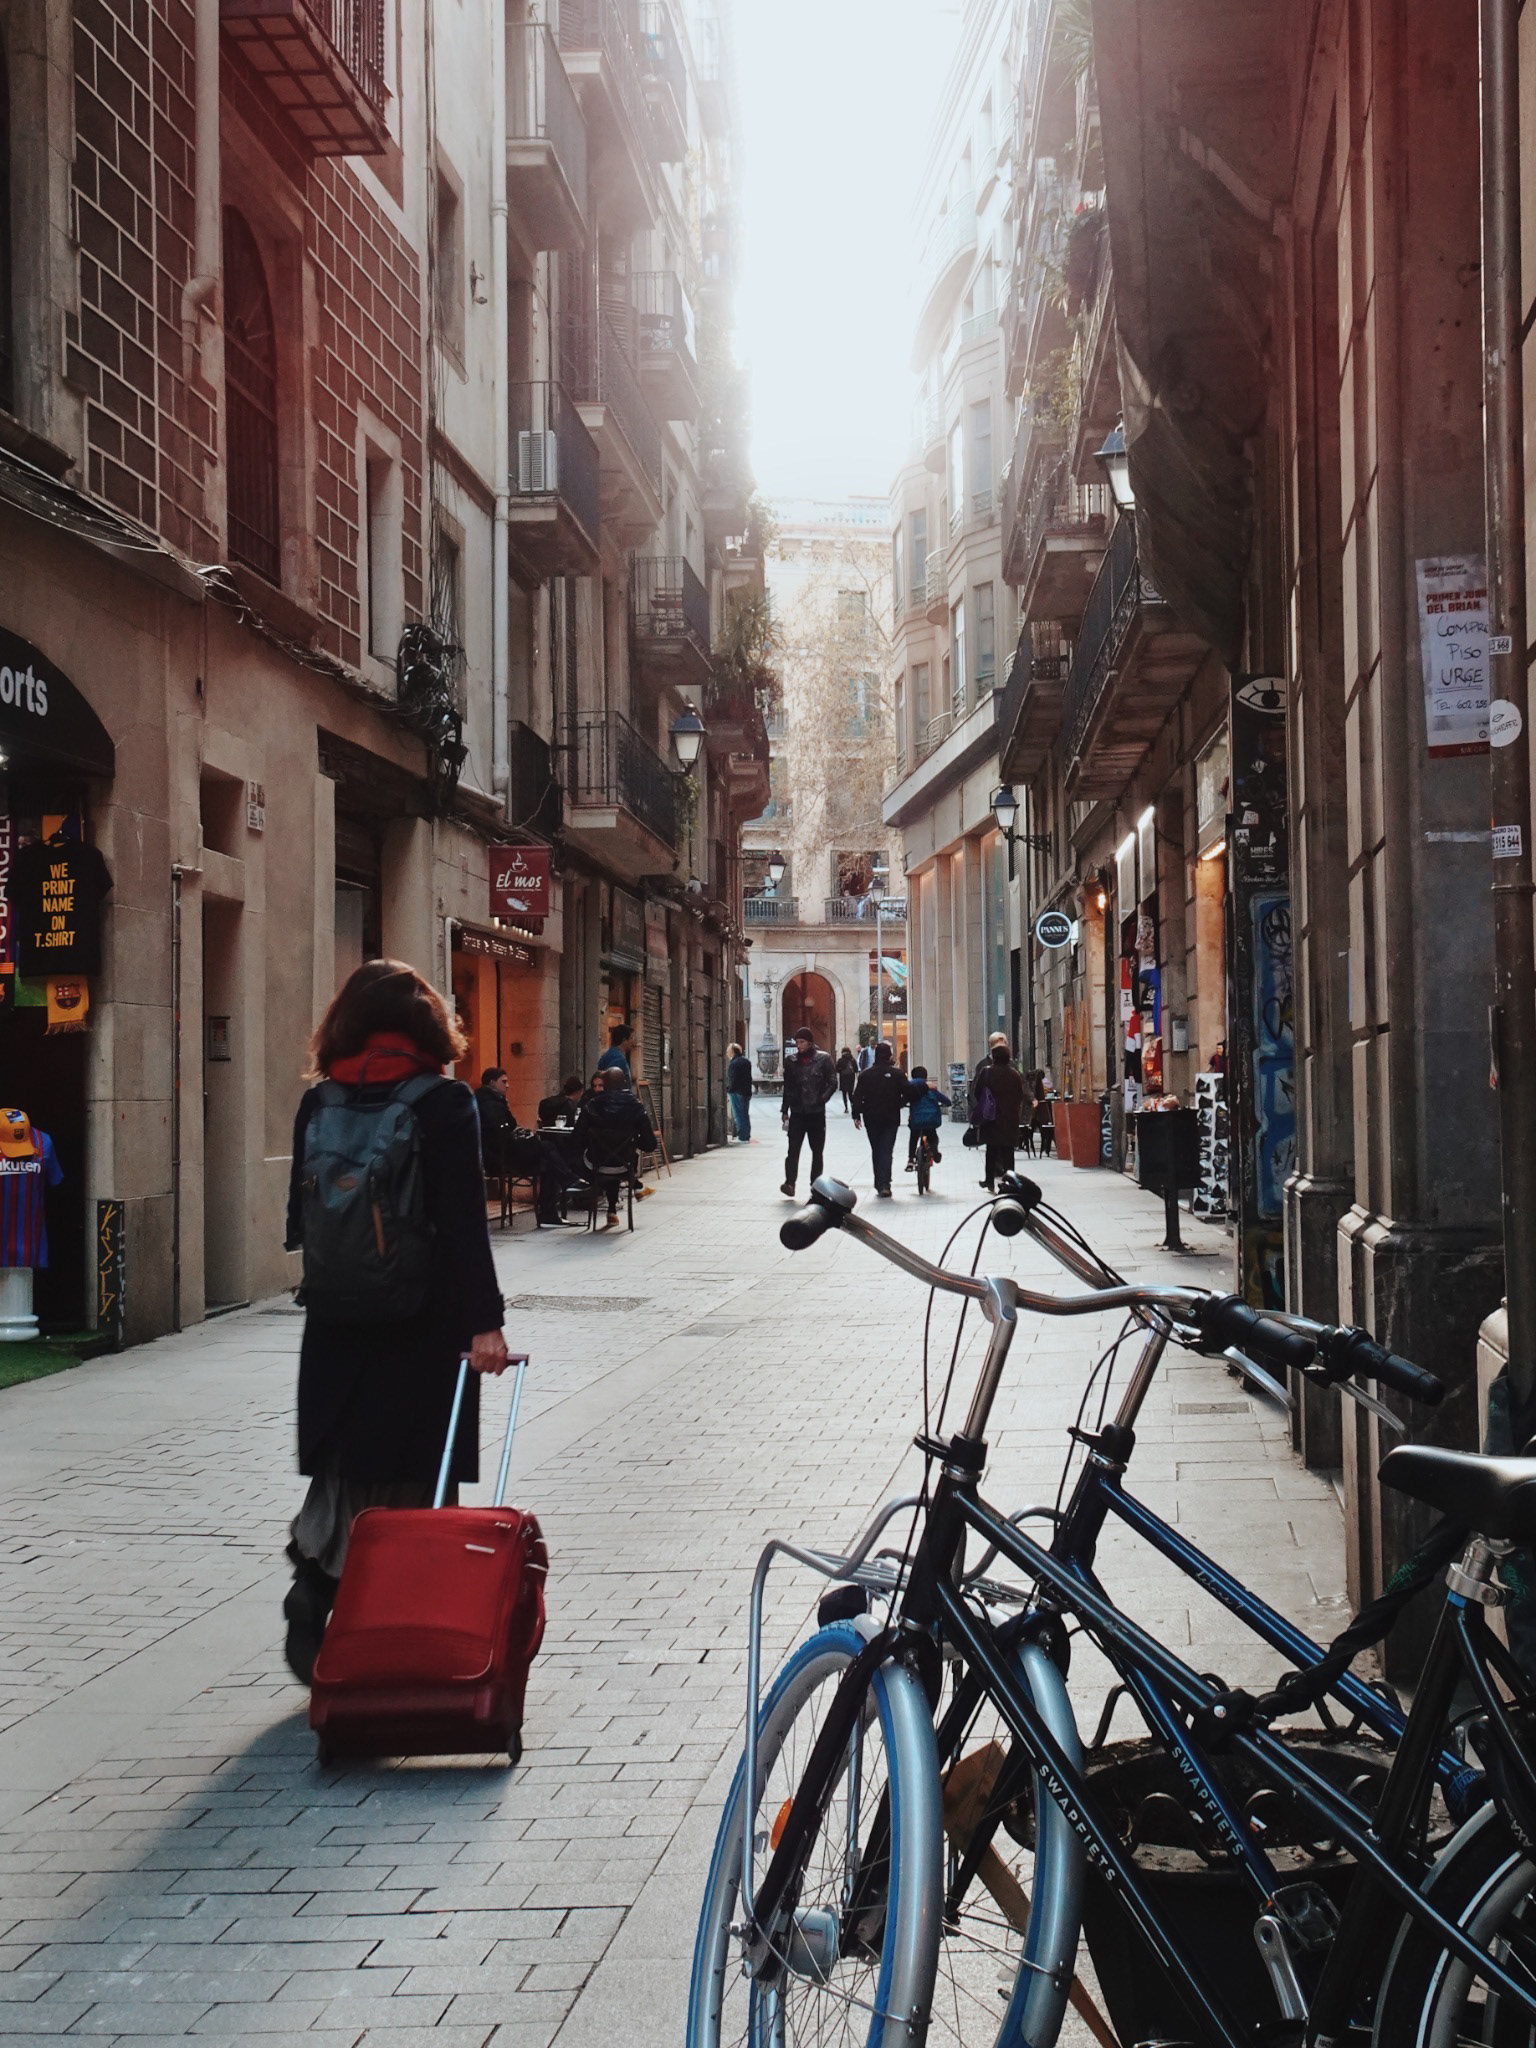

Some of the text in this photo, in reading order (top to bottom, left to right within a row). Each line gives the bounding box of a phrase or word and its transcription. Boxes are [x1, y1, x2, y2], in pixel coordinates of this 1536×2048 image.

[1427, 601, 1480, 614] DEL BRIAN
[1441, 668, 1484, 687] URGE
[50, 862, 69, 879] WE
[496, 870, 542, 888] El mos
[42, 879, 76, 896] PRINT
[42, 896, 74, 913] NAME
[51, 915, 66, 931] ON
[34, 931, 76, 948] T.SHIRT
[1172, 1746, 1244, 1856] SWAPFIETS
[1039, 1764, 1115, 1881] SWAPFIETS
